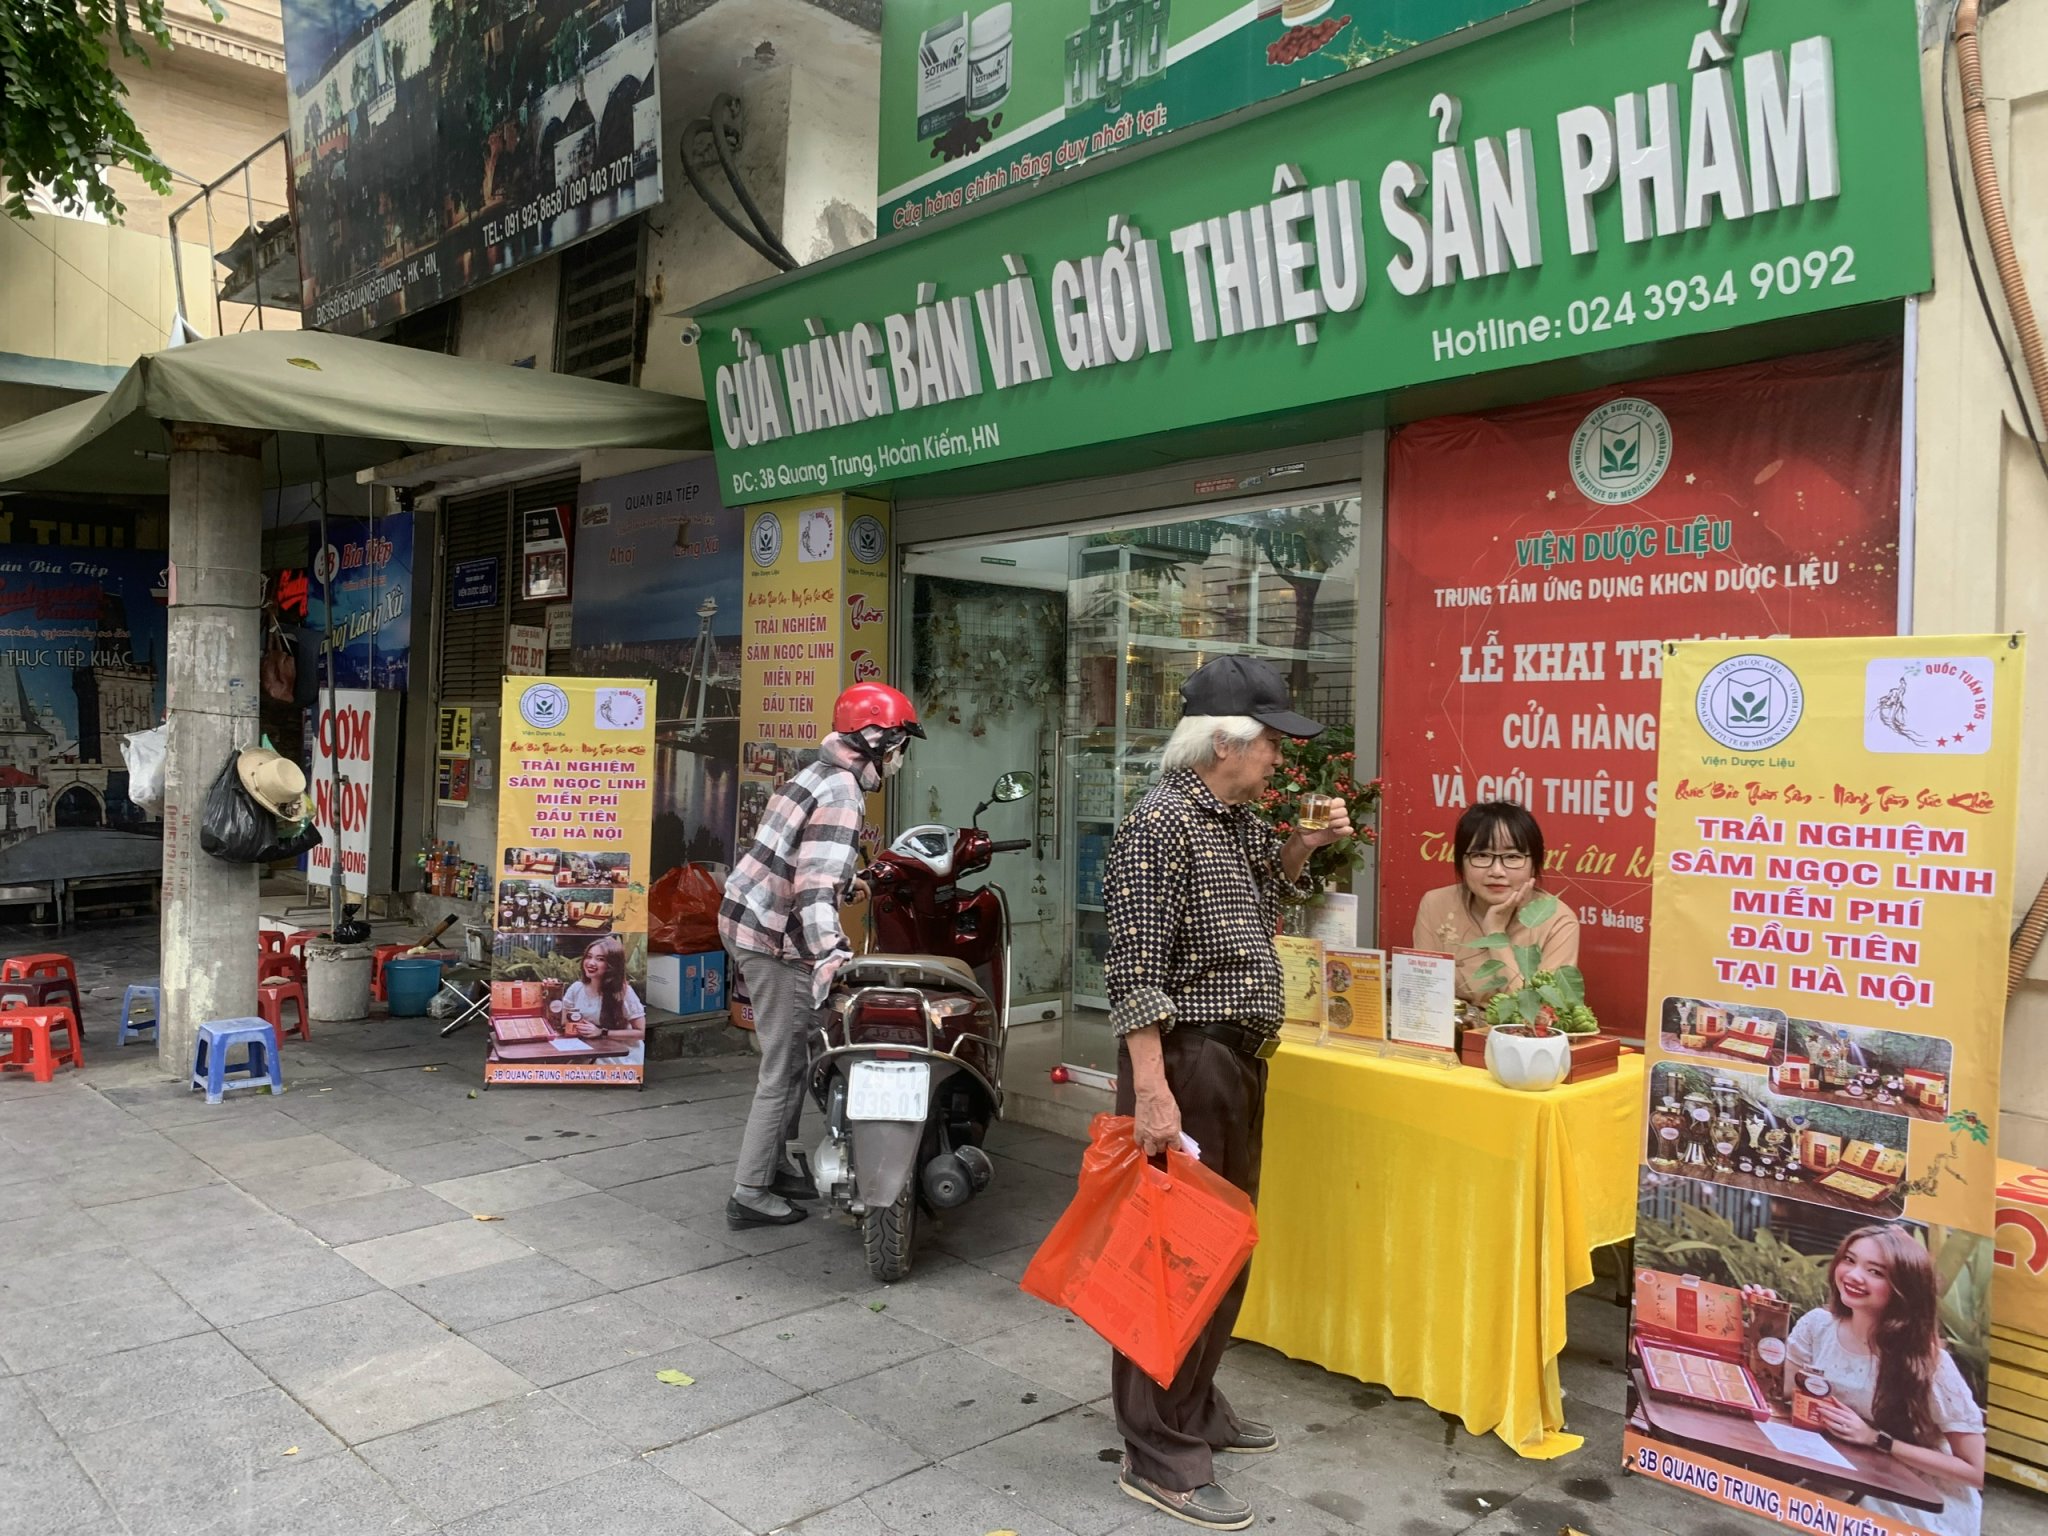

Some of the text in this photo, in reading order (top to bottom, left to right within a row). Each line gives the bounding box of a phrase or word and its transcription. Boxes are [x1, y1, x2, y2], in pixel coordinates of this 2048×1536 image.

[893, 103, 1167, 230] Cửa hàng chính hãng duy nhất tại:
[482, 152, 635, 248] TEL: 091 925 8658 090 403 7071
[714, 0, 1841, 451] CỬA HÀNG BÁN VÀ GIỚI THIỆU SẢN PHẨM
[350, 282, 376, 311] QUANG
[376, 269, 402, 299] TRUNG
[407, 260, 419, 285] HK
[1567, 289, 1637, 335] 024
[1643, 270, 1738, 321] 3934
[1749, 245, 1857, 301] 9092
[1590, 402, 1653, 425] VIỆN DƯỢC LIỆU
[1575, 432, 1587, 469] NATIONAL
[1655, 422, 1667, 469] MATERIALS
[733, 471, 758, 494] ĐC:
[759, 468, 776, 489] 3B
[778, 462, 827, 486] Quang
[830, 454, 878, 478] Trung,
[878, 438, 921, 468] Hoàn
[656, 490, 673, 505] BIA
[1577, 471, 1606, 498] INSTITUTE
[1607, 491, 1618, 499] OF
[341, 542, 365, 570] Bia
[1515, 515, 1732, 572] VIỆN DƯỢC LIỆU
[29, 560, 62, 574] Bia
[1434, 556, 1839, 608] TRUNG TÂM ỨNG DỤNG KHCN DƯỢC LIỆU
[754, 611, 827, 635] TRẢI NGHIỆM
[6, 649, 51, 671] THỰC
[746, 641, 834, 663] SÂM NGỌC LINH
[1460, 630, 1504, 683] LỄ
[1513, 642, 1605, 682] KHAI
[763, 665, 814, 687] MIỄN PHÍ
[1925, 661, 1987, 720] QUỐC TUẤN 19/5
[762, 691, 814, 713] ĐẦU TIÊN
[319, 704, 372, 761] CƠM
[758, 719, 817, 741] TẠI HÀ NỘI
[1503, 699, 1656, 751] CỬA HÀNG
[1739, 740, 1751, 748] OF
[521, 759, 635, 775] TRẢI NGHIỆM
[1701, 756, 1796, 770] Viện Dược Liệu
[509, 775, 646, 791] SÂM NGỌC LINH
[536, 791, 618, 806] MIỄN PHÍ
[1432, 765, 1466, 809] VÀ
[1477, 767, 1533, 813] GIỚI
[1543, 769, 1635, 824] THIỆU
[536, 808, 617, 823] ĐẦU TIÊN
[531, 825, 623, 841] TẠI HÀ NỘI
[1697, 815, 1965, 857] TRẢI NGHIỆM
[1575, 845, 1617, 876] ân
[1671, 849, 1754, 876] SÂM
[1768, 857, 1879, 888] NGỌC
[1896, 866, 1994, 895] LINH
[1578, 906, 1645, 934] 15 tháng
[1733, 887, 1924, 927] MIỄN PHÍ
[1730, 922, 1917, 965] ĐẦU TIÊN
[1714, 960, 1933, 1009] TẠI HÀ NỘI
[505, 1070, 534, 1081] QUANG
[1638, 1447, 1839, 1534] 3B QUANG TRUNG, HOÀN
